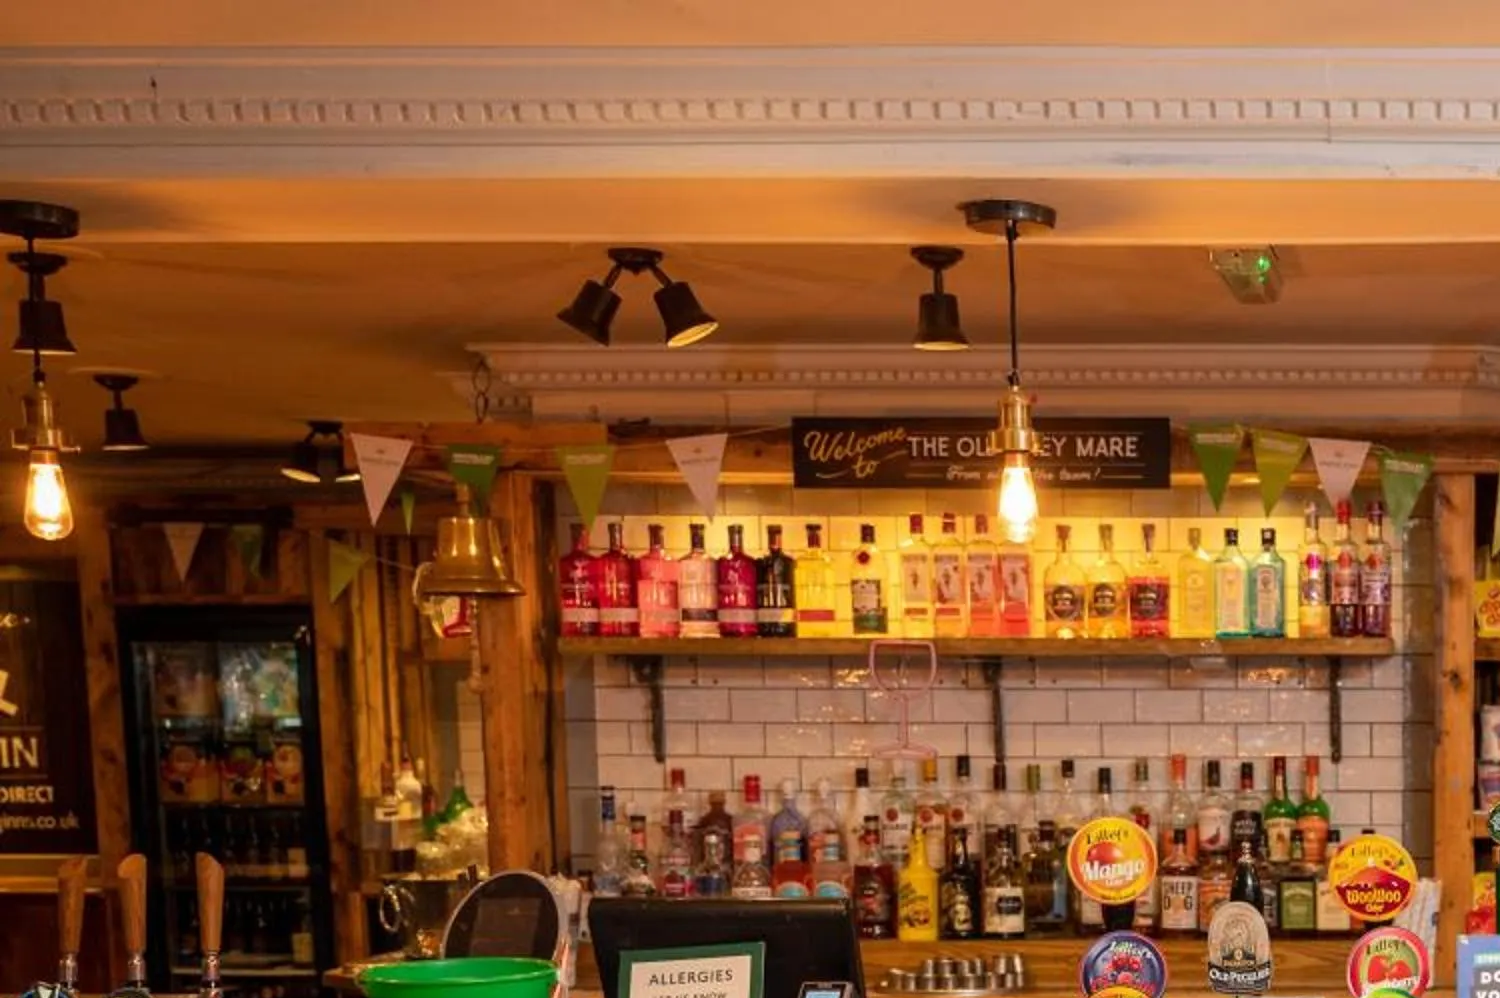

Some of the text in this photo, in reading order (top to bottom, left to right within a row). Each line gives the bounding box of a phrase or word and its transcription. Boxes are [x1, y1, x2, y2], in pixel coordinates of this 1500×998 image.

[803, 426, 907, 463] Welcome
[908, 436, 949, 457] THE
[1076, 436, 1138, 457] MARE
[852, 455, 881, 479] to
[945, 464, 981, 481] From
[1081, 859, 1146, 881] Mango
[649, 969, 733, 986] ALLERGIES
